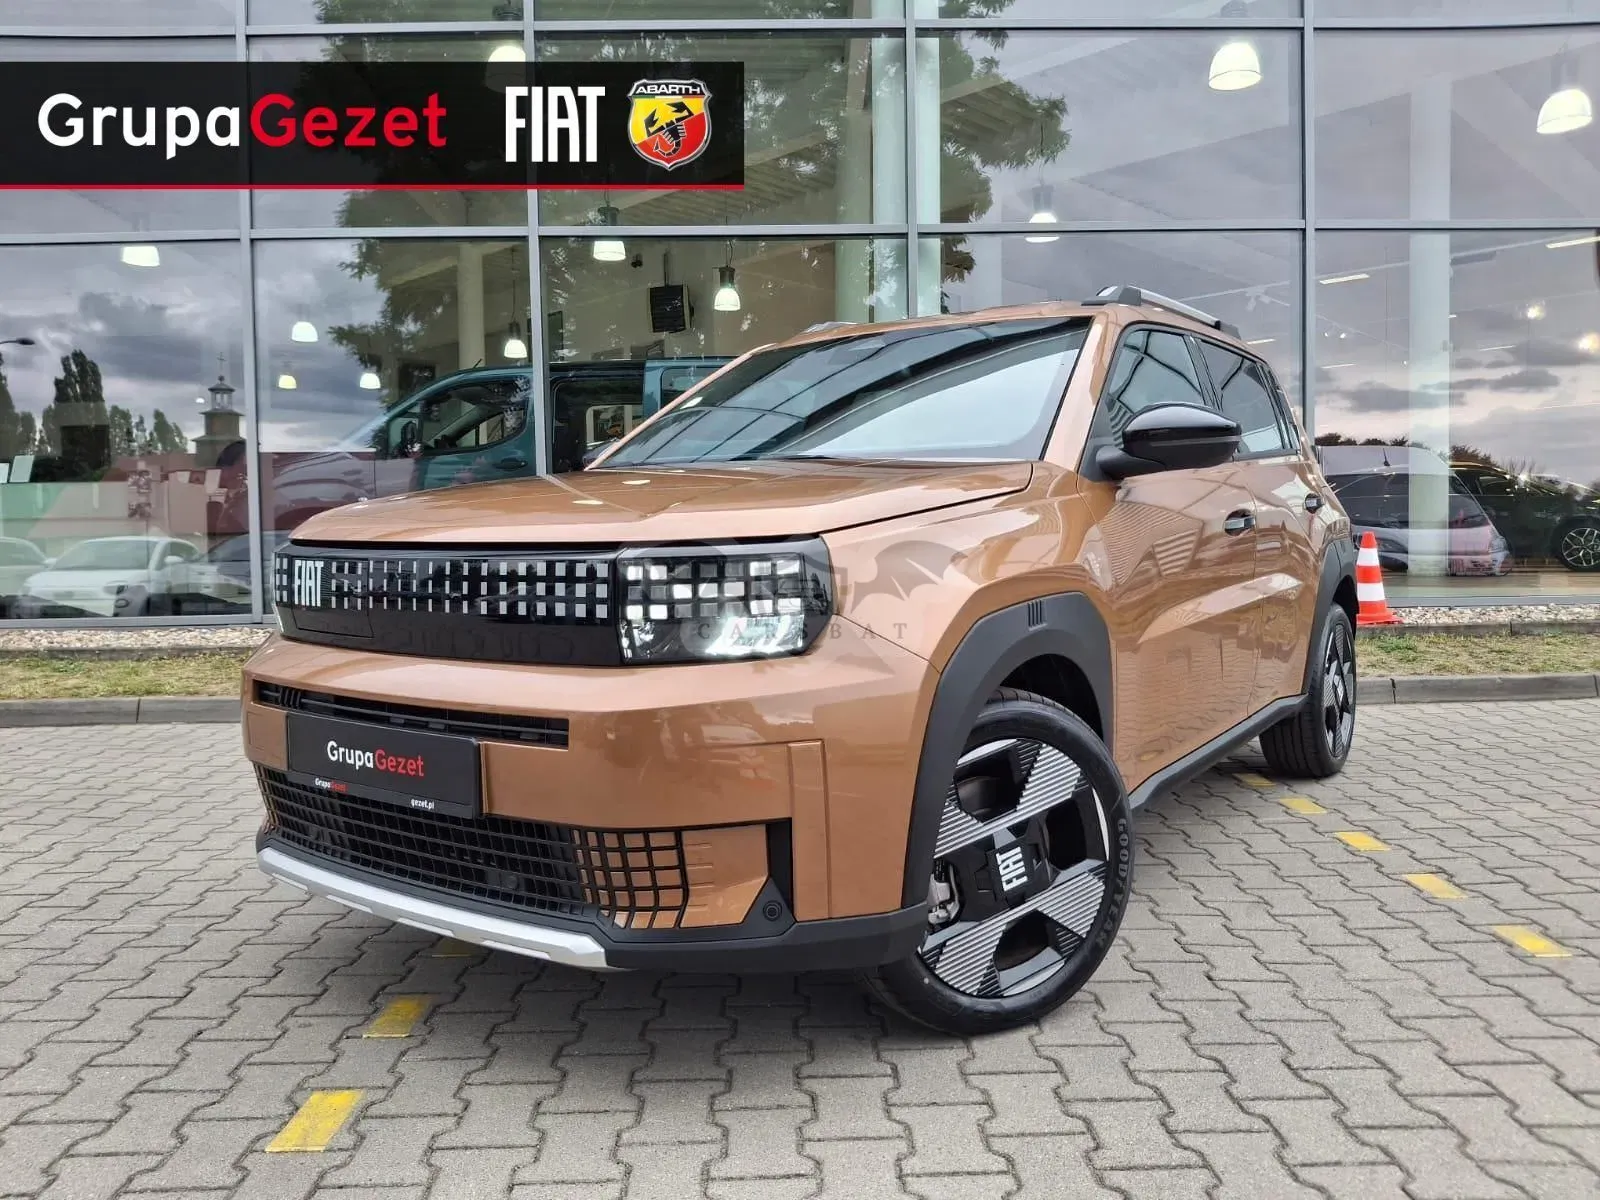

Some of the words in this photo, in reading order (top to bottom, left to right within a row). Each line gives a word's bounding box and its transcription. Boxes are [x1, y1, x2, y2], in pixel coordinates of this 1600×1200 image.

[294, 559, 324, 607] FIAT
[410, 798, 435, 810] gezet.pl
[995, 846, 1028, 892] FIAT
